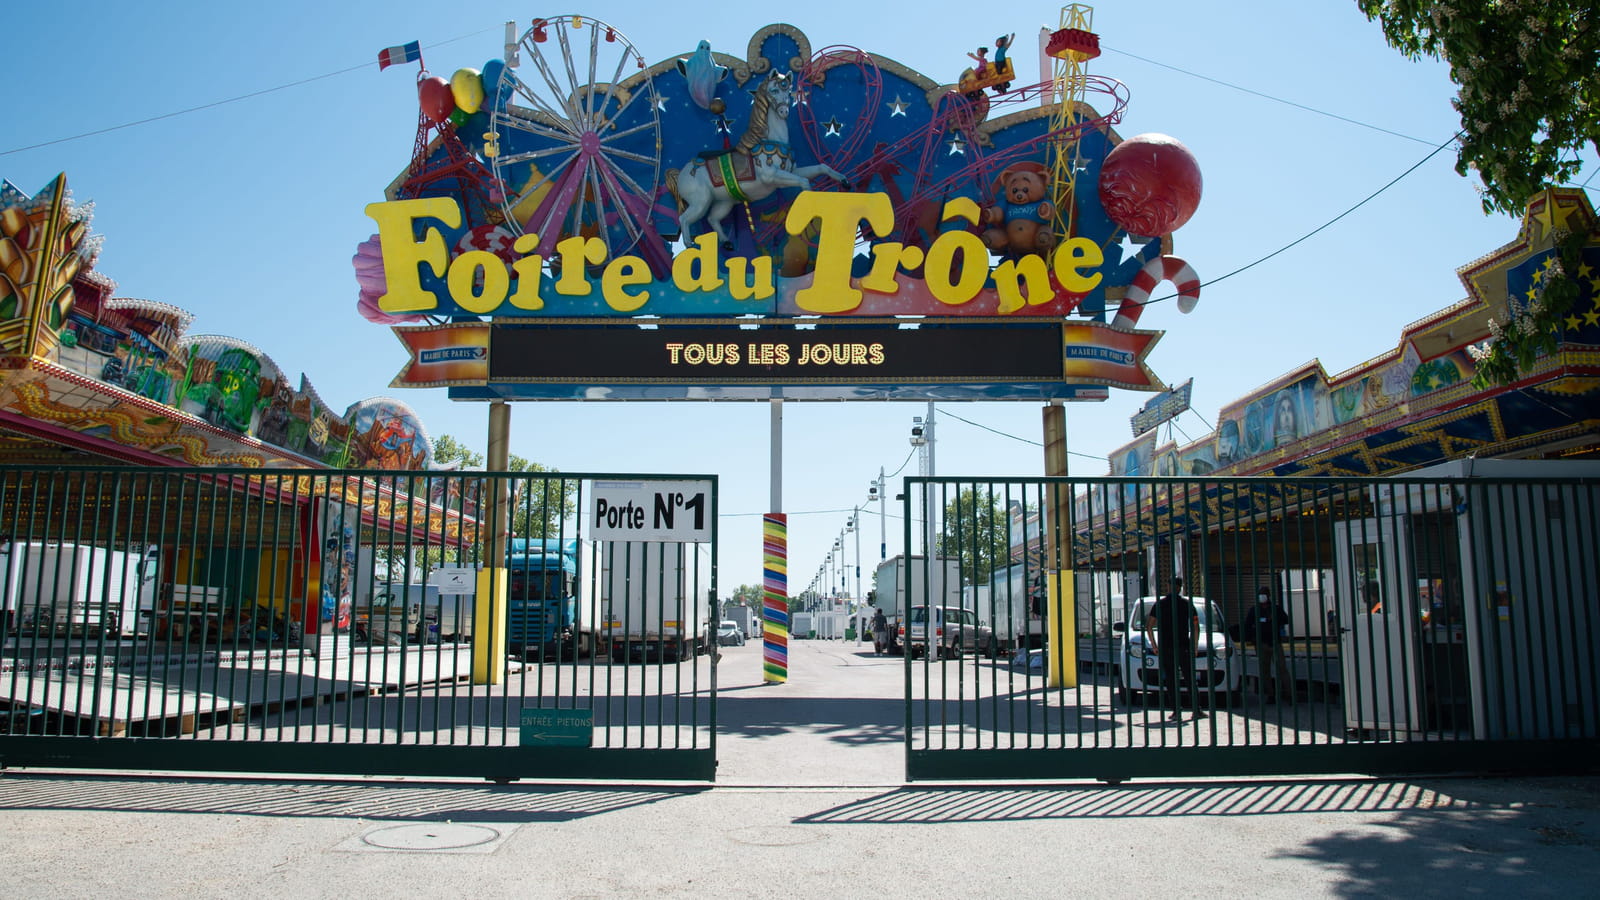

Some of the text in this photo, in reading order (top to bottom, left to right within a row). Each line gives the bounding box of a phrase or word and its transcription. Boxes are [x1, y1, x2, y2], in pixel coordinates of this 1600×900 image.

[365, 190, 1103, 315] Foire du Trône
[423, 349, 470, 360] MAIRIE DE PARIS
[666, 343, 885, 365] TOUS LES JOURS
[1070, 347, 1124, 361] MAIRIE DE PARIS
[596, 492, 704, 530] Porte N°1
[557, 717, 592, 728] PIETONS
